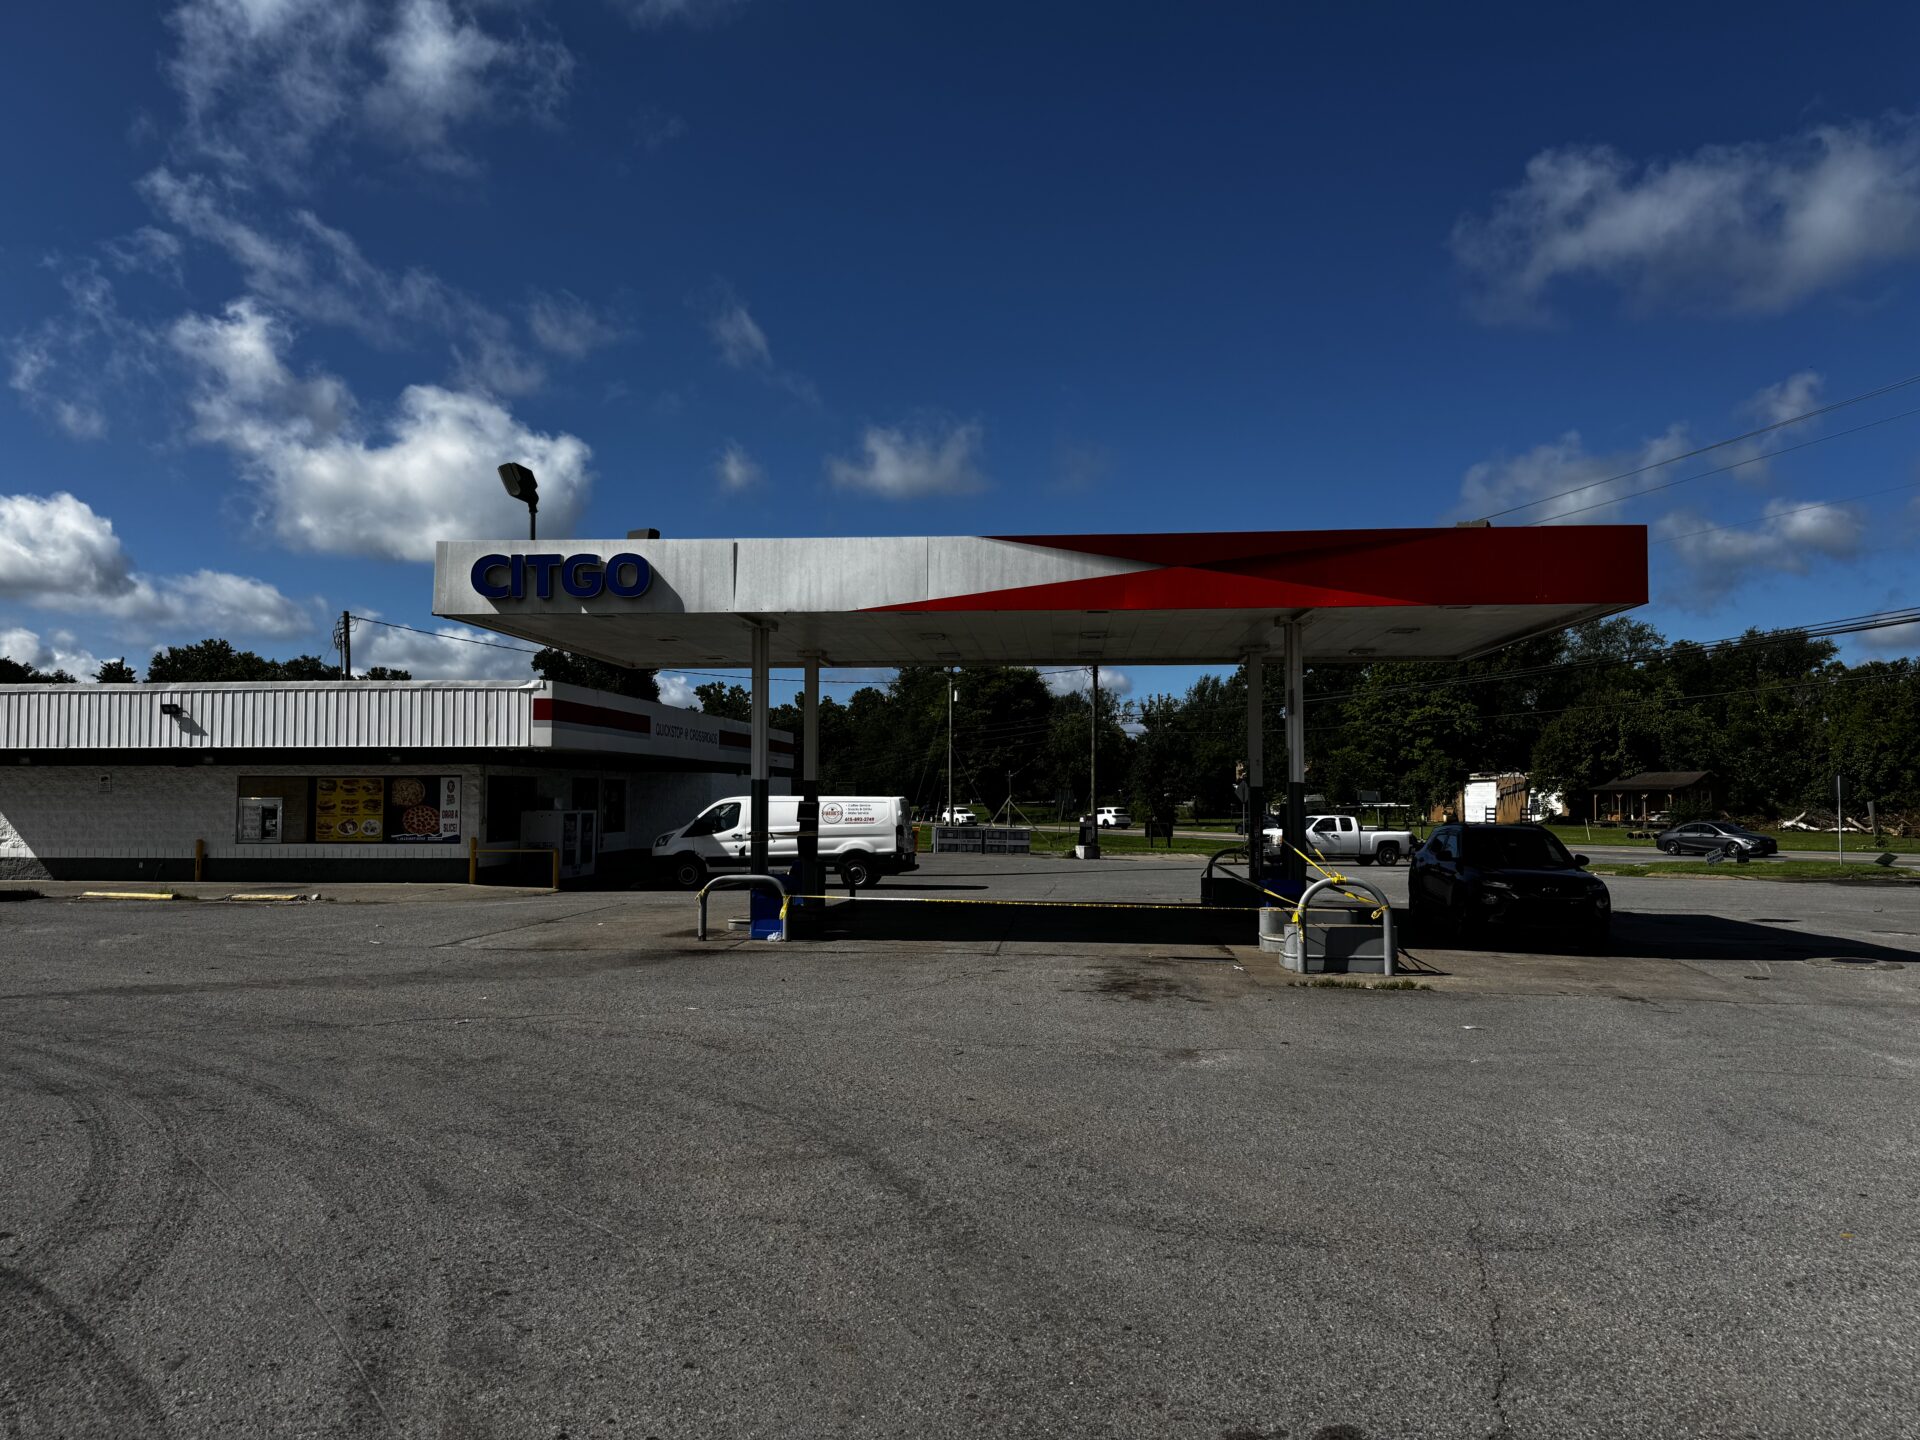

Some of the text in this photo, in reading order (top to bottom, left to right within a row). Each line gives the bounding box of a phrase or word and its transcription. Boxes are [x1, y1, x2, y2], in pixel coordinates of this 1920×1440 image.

[470, 551, 653, 599] CITGO
[655, 722, 684, 740] QUICKSTOP
[689, 728, 718, 745] CROSSROADS
